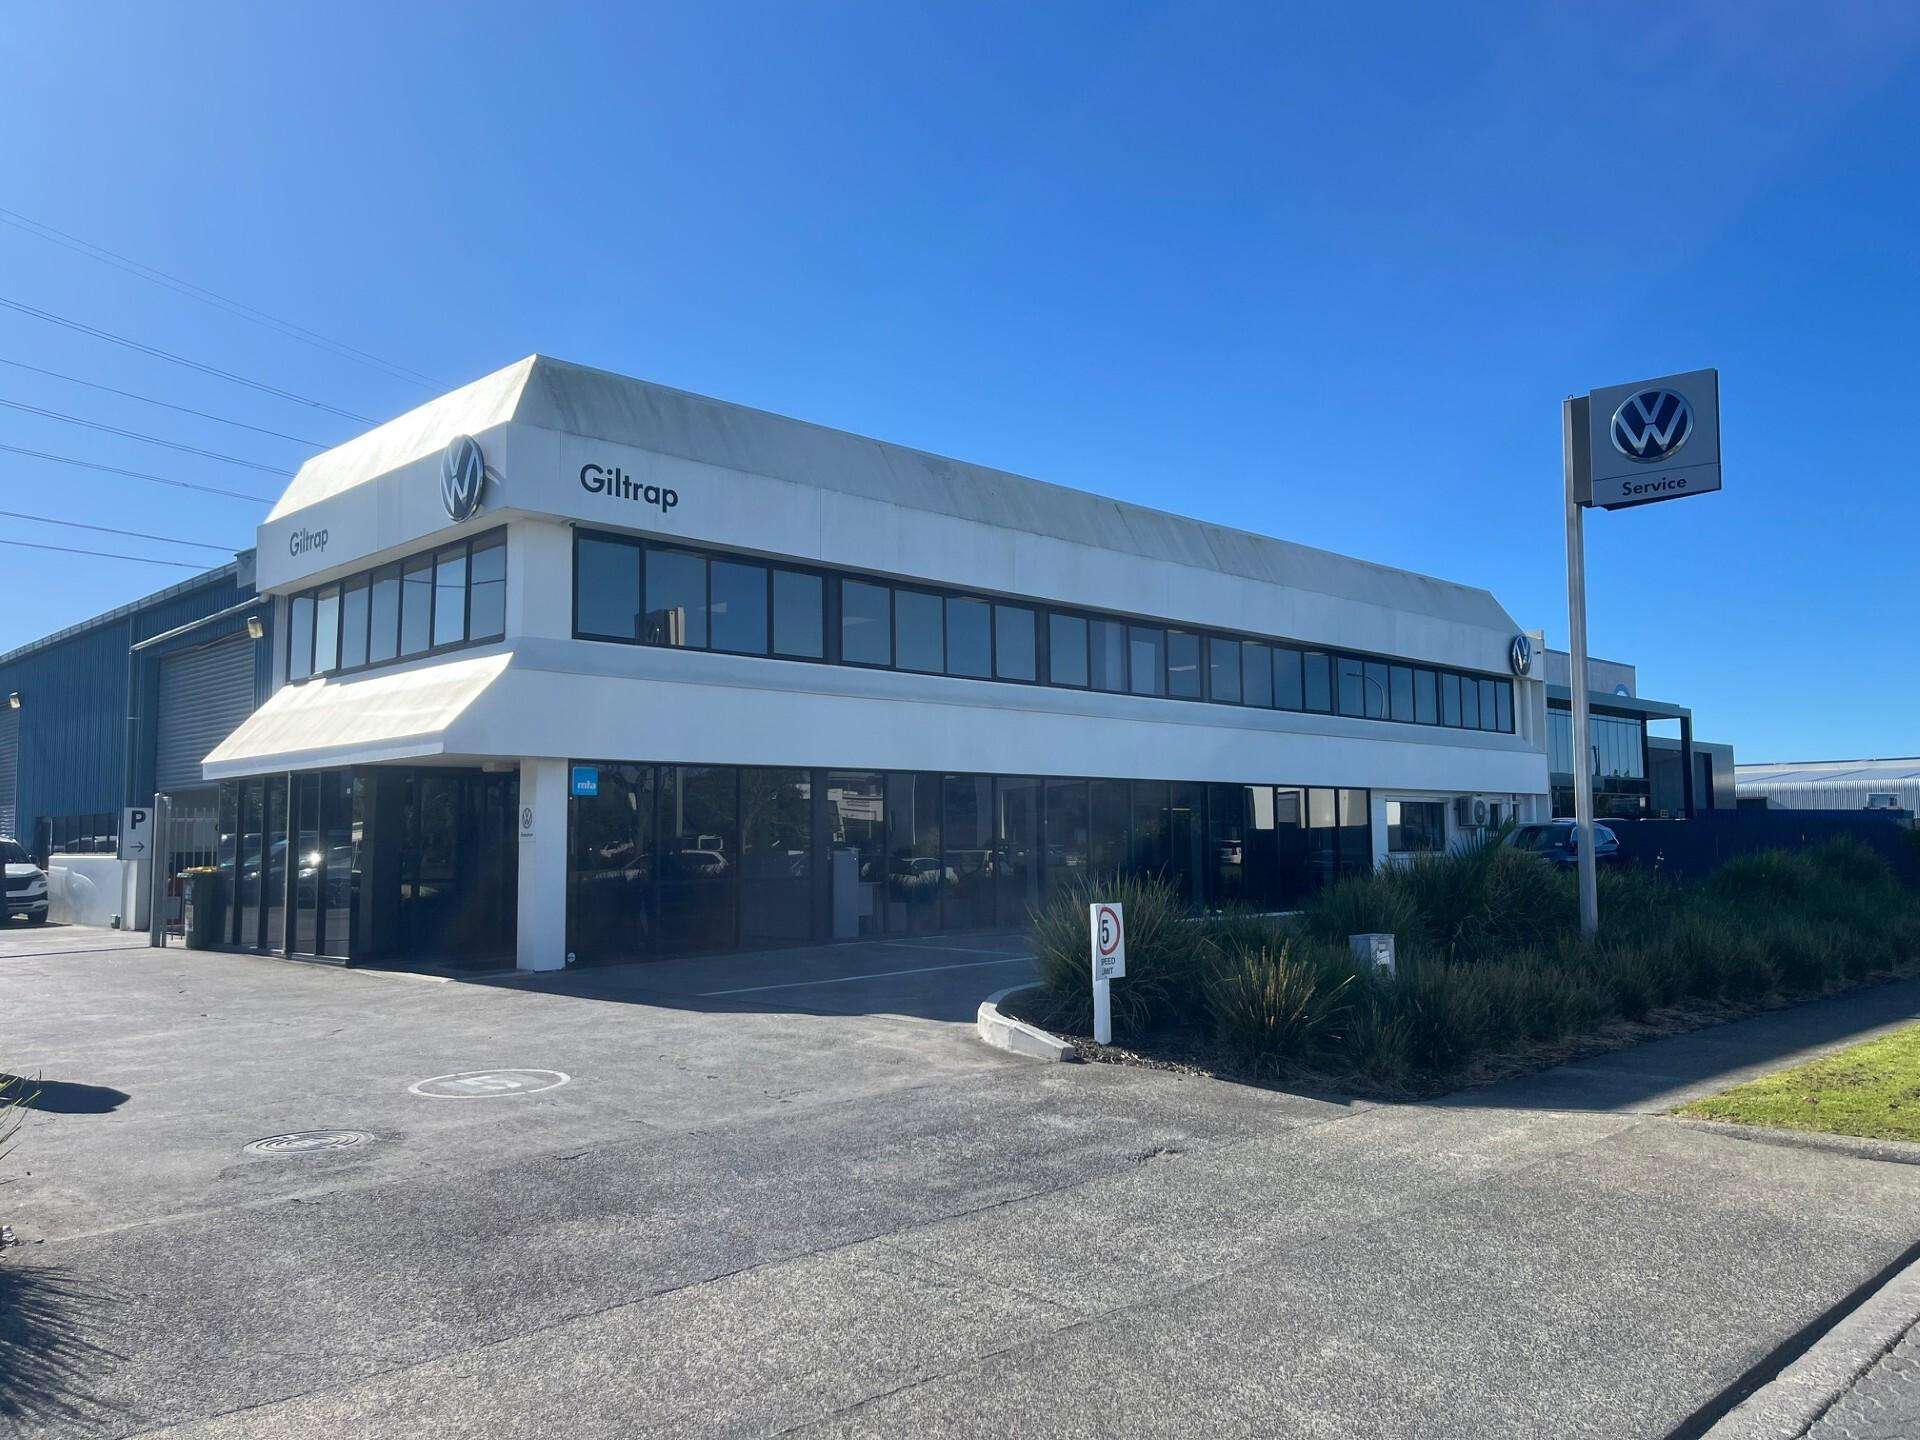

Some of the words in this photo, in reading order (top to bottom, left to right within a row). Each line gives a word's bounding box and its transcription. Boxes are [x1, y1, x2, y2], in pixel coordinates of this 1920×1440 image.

[580, 463, 679, 513] Giltrap
[1622, 477, 1687, 496] Service
[290, 528, 329, 557] Giltrap
[131, 810, 146, 830] P
[1102, 920, 1109, 944] 5
